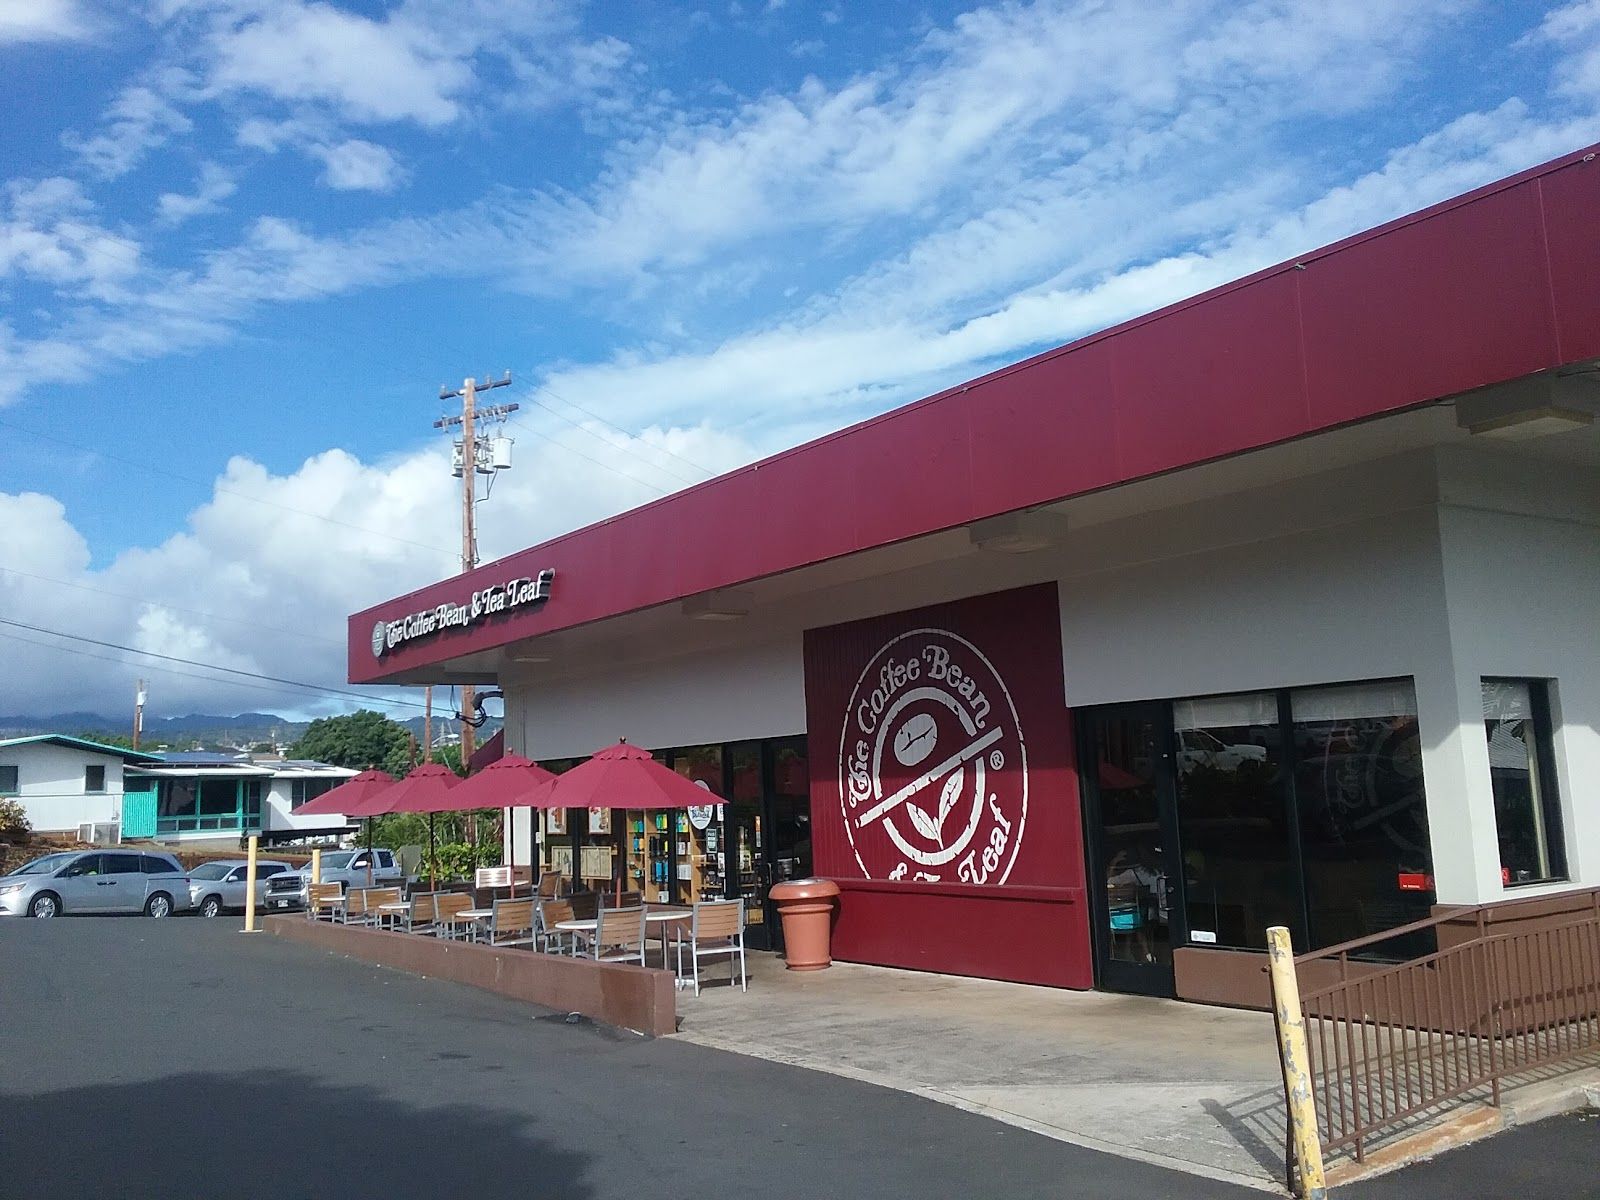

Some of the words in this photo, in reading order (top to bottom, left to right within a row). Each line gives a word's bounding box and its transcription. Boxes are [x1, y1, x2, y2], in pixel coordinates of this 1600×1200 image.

[386, 621, 403, 648] The
[403, 611, 436, 641] Coffee
[436, 605, 468, 629] Bean
[471, 592, 482, 618] &
[483, 586, 505, 614] Tea
[507, 570, 546, 606] Leaf
[857, 657, 920, 734] Coffee
[922, 645, 991, 728] Bean
[848, 739, 872, 808] The
[958, 793, 1011, 885] Leaf
